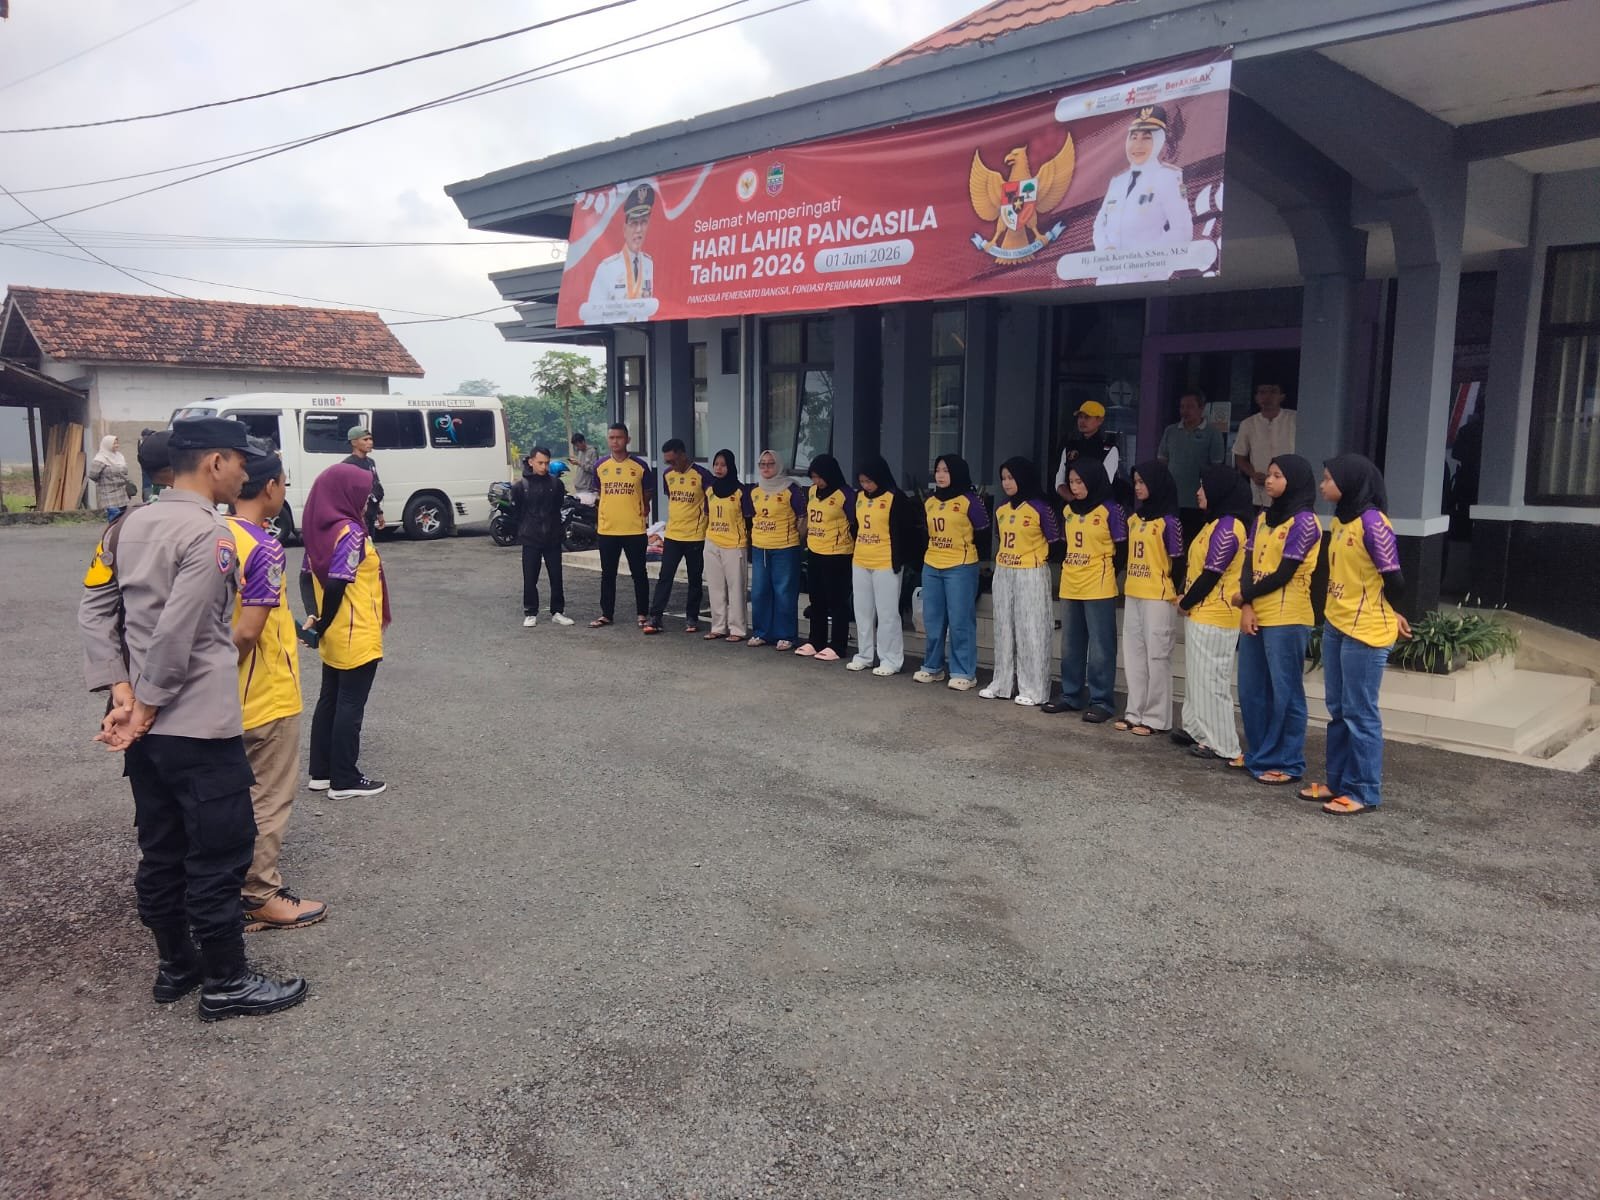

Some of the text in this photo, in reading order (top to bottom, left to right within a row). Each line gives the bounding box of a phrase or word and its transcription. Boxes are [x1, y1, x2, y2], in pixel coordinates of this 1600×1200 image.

[694, 195, 842, 233] Selamat Memperingati
[691, 205, 938, 260] HARI LAHIR PANCASILA
[825, 246, 901, 267] 01 Juni 2026
[690, 252, 805, 285] Tahun 2026
[687, 293, 720, 304] PANCASILA
[721, 289, 761, 301] PEMERSATU
[791, 282, 824, 295] FONDASI
[824, 277, 875, 292] PERDAMAIAN
[875, 274, 902, 287] DUNIA
[716, 505, 723, 518] 11
[761, 508, 769, 518] 2
[810, 509, 823, 523] 20
[863, 515, 871, 529] 5
[933, 517, 945, 532] 10
[1004, 531, 1016, 549] 12
[1075, 531, 1083, 548] 9
[1133, 541, 1144, 559] 13
